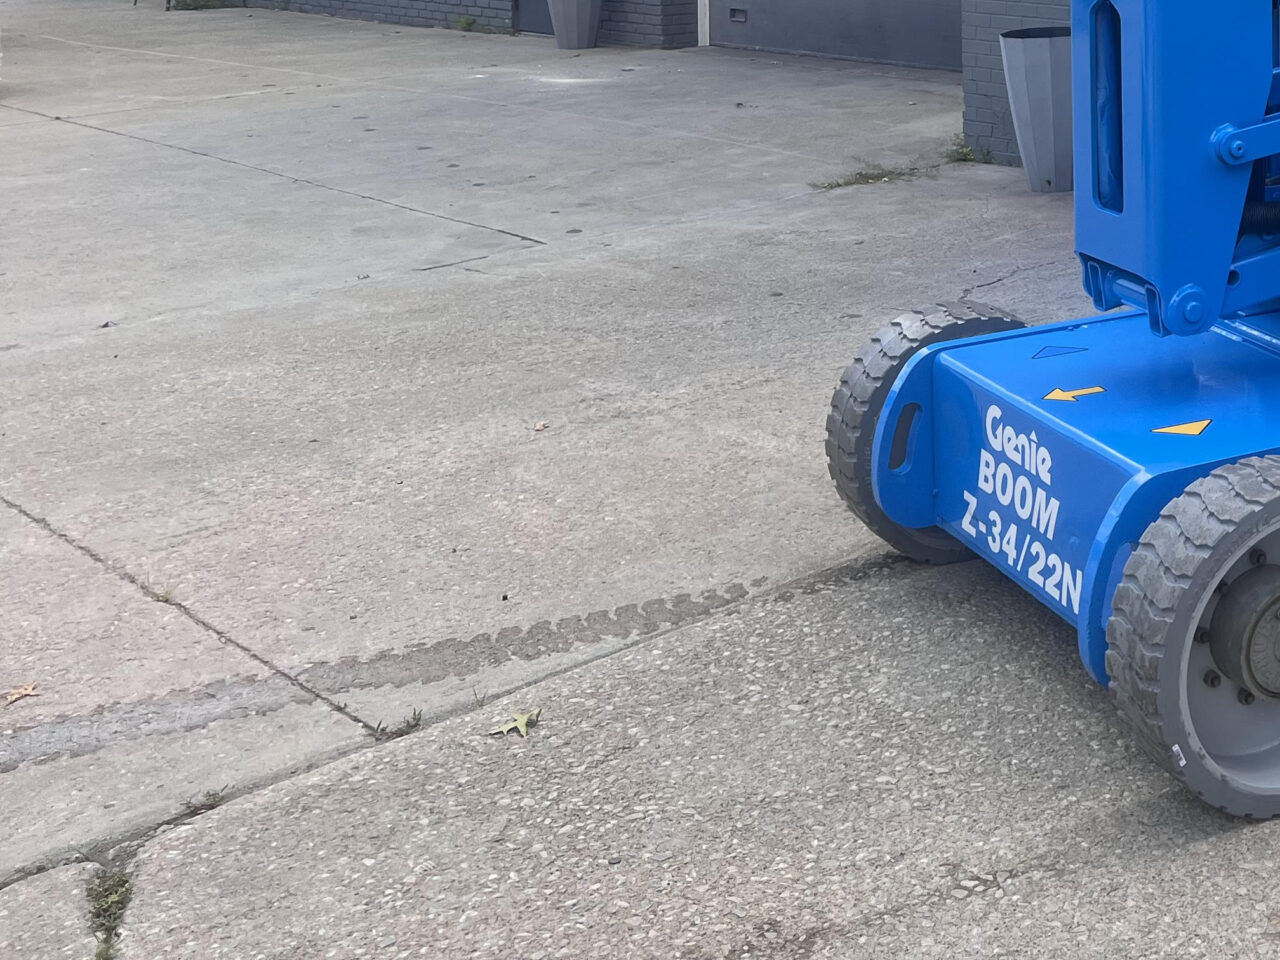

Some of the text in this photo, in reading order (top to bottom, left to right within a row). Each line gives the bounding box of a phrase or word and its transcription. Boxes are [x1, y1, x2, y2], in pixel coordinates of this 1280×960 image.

[985, 404, 1052, 486] Genie
[977, 448, 1061, 541] BOOM
[960, 489, 1084, 616] Z-34/22N
